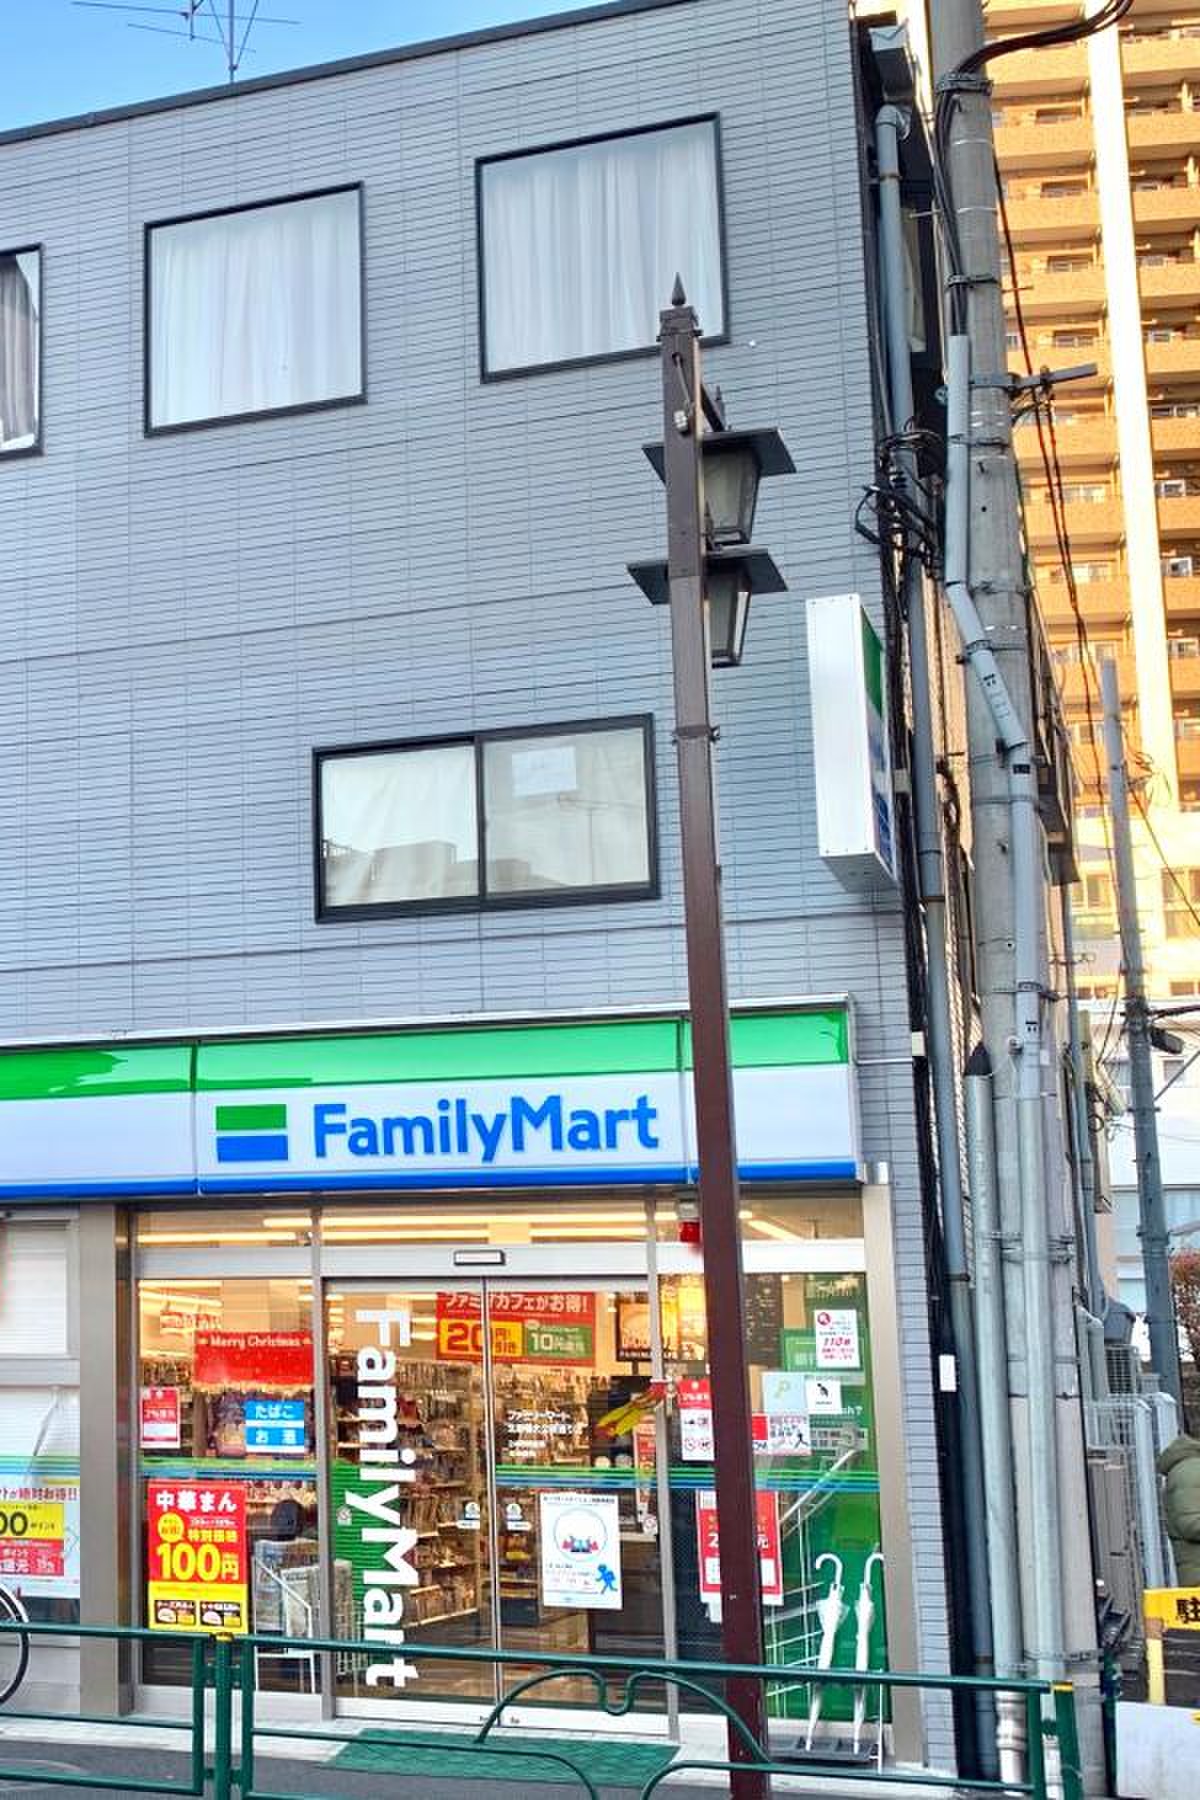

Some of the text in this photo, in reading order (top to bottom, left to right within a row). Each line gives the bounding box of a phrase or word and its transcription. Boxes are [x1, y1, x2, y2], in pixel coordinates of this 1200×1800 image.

[313, 1094, 660, 1164] FamilyMart
[210, 1333, 300, 1349] Merry Christmas
[255, 1404, 296, 1419] たばこ
[156, 1490, 238, 1513] 中華まん
[344, 1308, 420, 1688] FamilyMart
[156, 1542, 240, 1582] 100円
